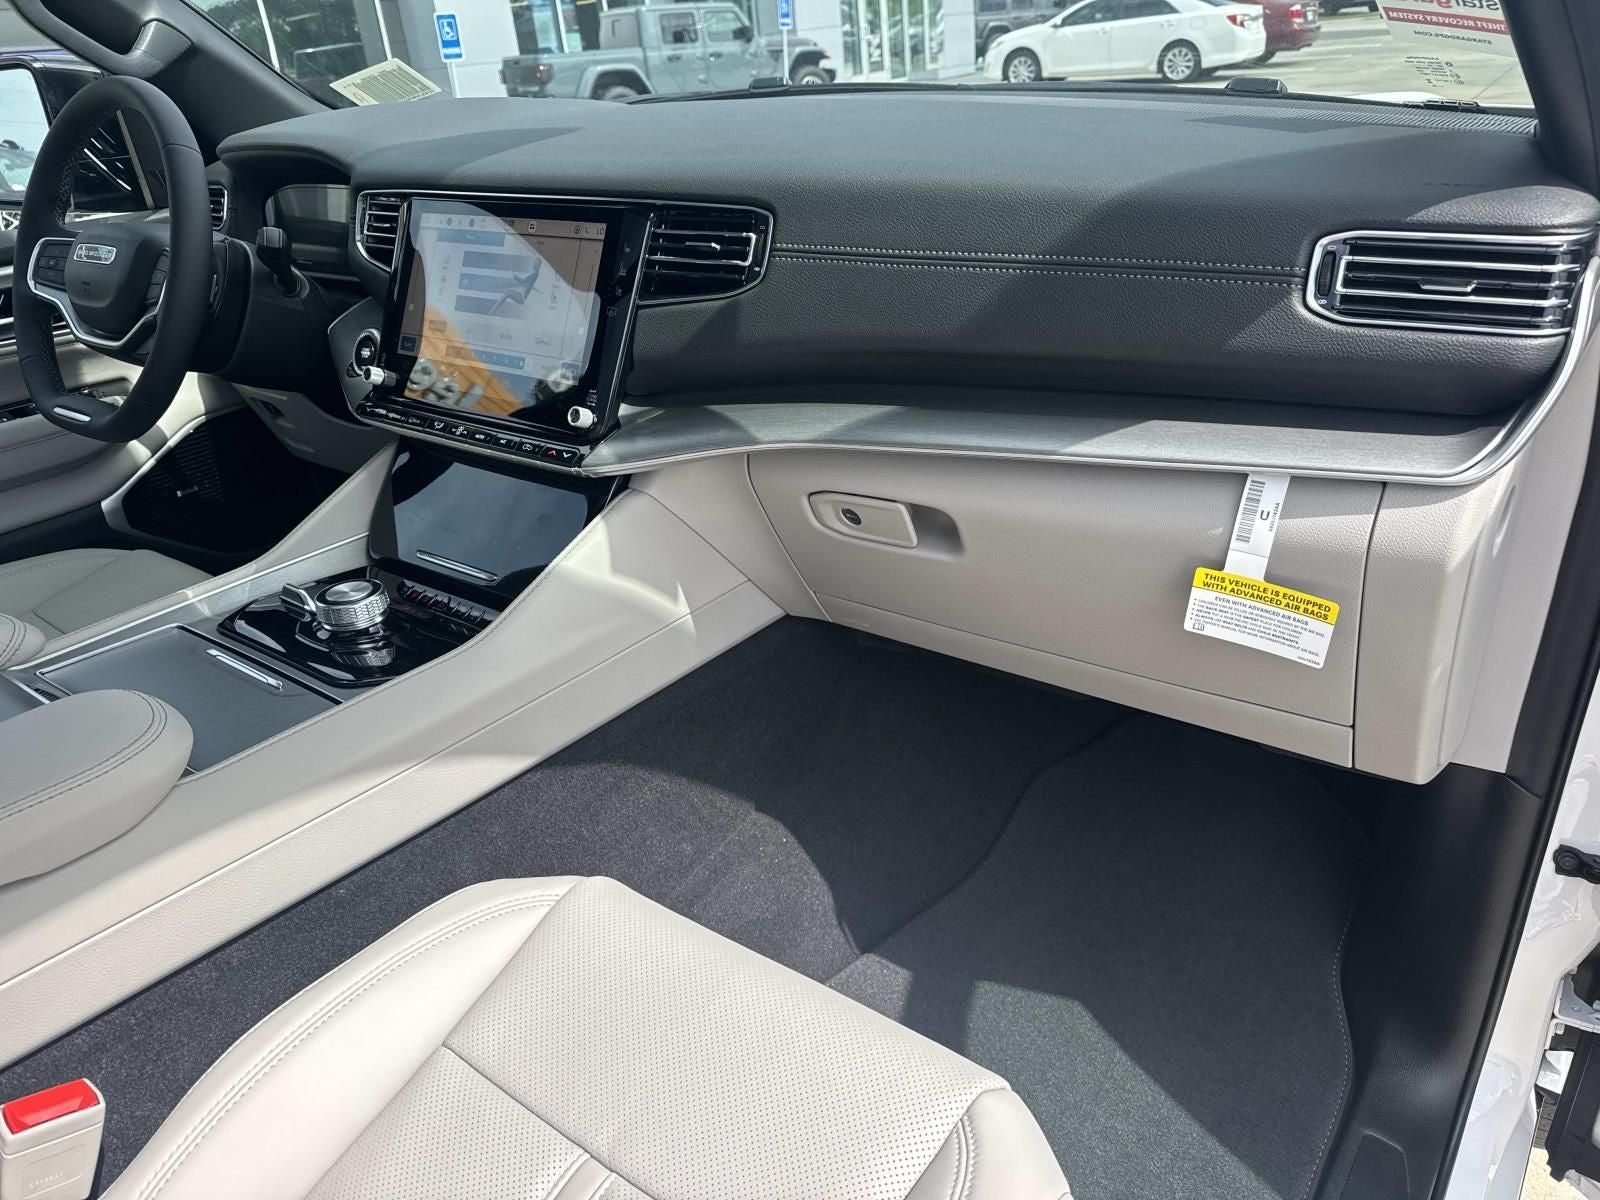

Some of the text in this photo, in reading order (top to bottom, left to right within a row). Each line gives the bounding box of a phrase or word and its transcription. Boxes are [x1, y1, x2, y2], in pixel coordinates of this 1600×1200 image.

[1260, 510, 1270, 520] U
[1202, 579, 1329, 620] WITH ADVANCED AIR BAGS
[1204, 572, 1331, 612] THIS VEHICLE IS EQUIPPED
[1214, 596, 1230, 604] EVEN
[1231, 600, 1246, 608] WITH
[1247, 604, 1280, 617] ADVANCED
[1292, 617, 1309, 625] BAGS
